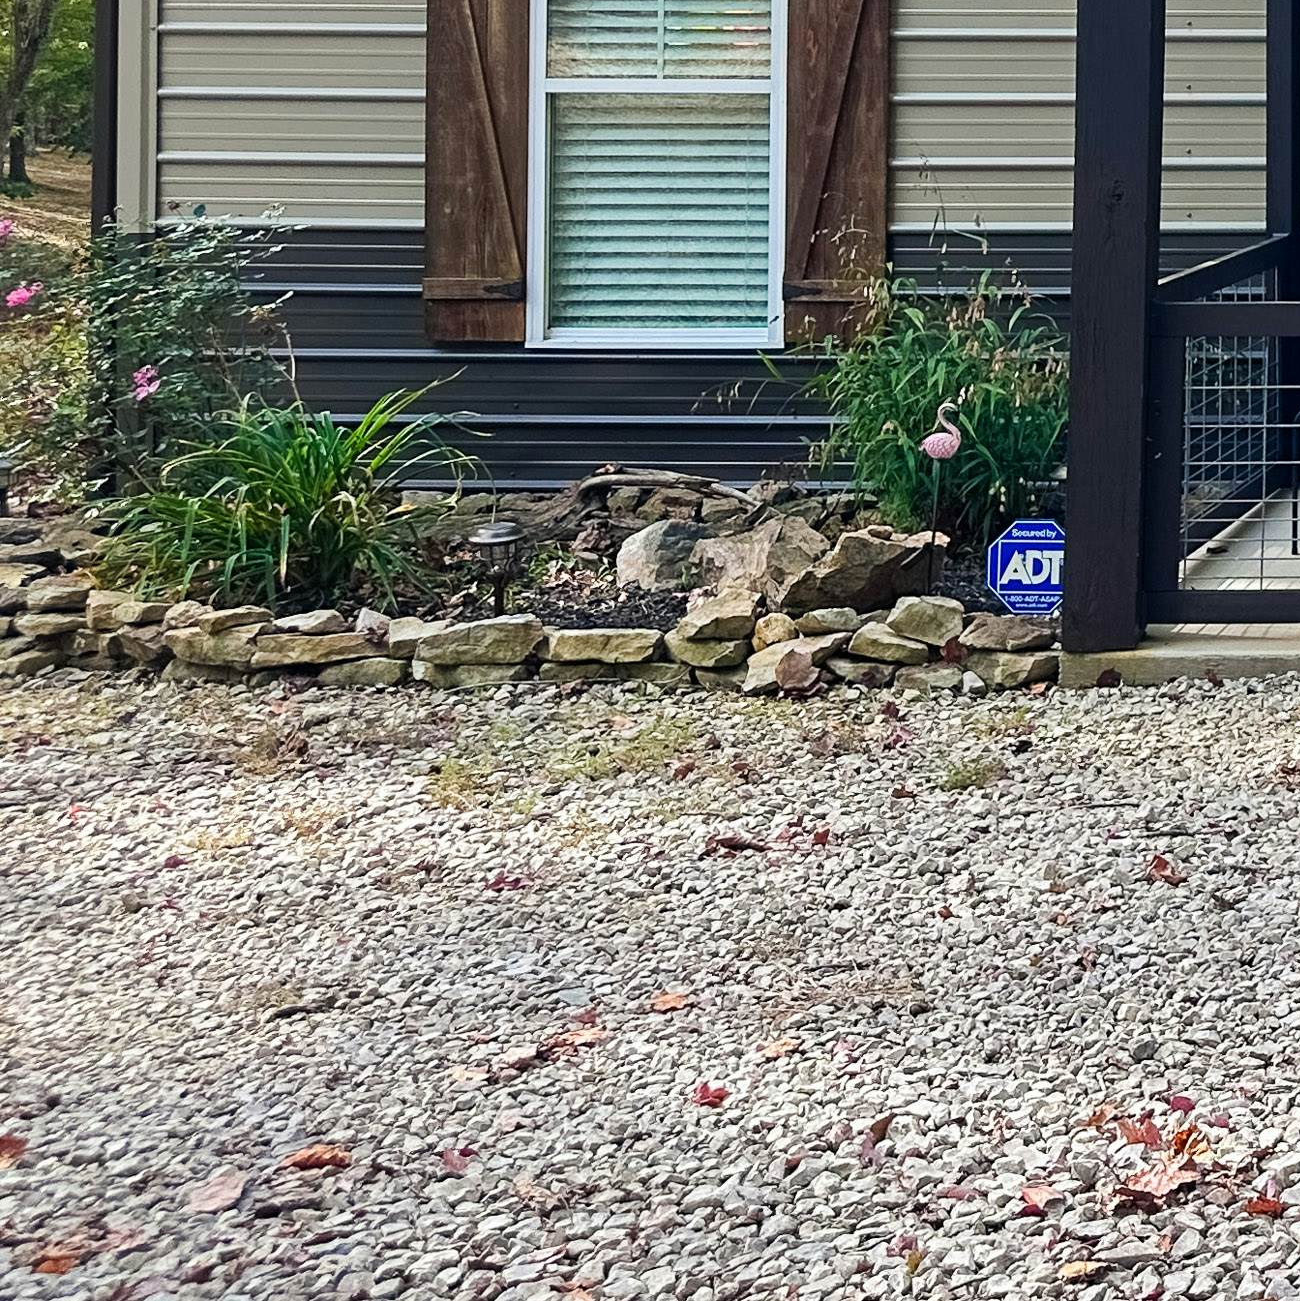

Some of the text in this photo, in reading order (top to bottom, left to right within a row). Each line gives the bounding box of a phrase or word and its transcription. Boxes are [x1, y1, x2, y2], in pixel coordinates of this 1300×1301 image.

[1011, 528, 1058, 539] Secured by
[1000, 550, 1064, 585] ADT
